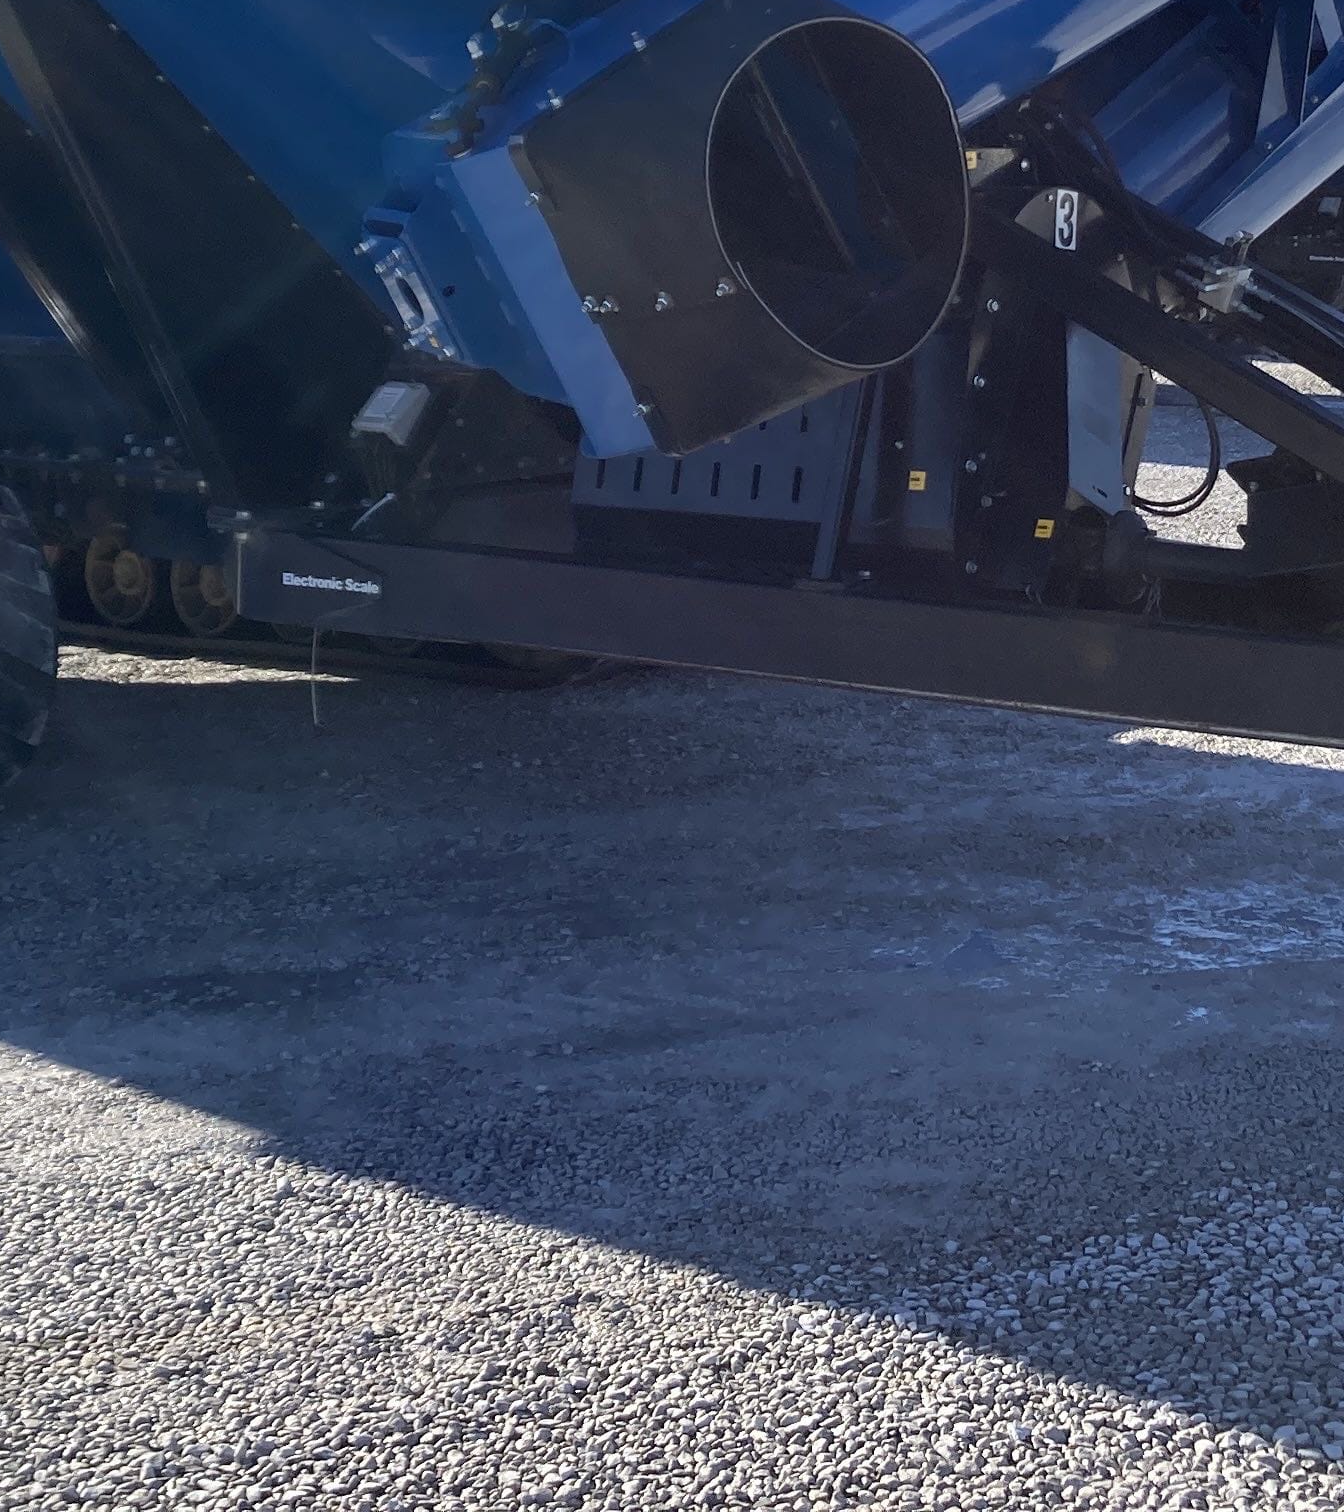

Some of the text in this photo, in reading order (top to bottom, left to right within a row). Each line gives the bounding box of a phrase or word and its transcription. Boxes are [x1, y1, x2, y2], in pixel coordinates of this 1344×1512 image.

[1058, 192, 1075, 248] 3
[282, 572, 380, 594] Electronic Scale
